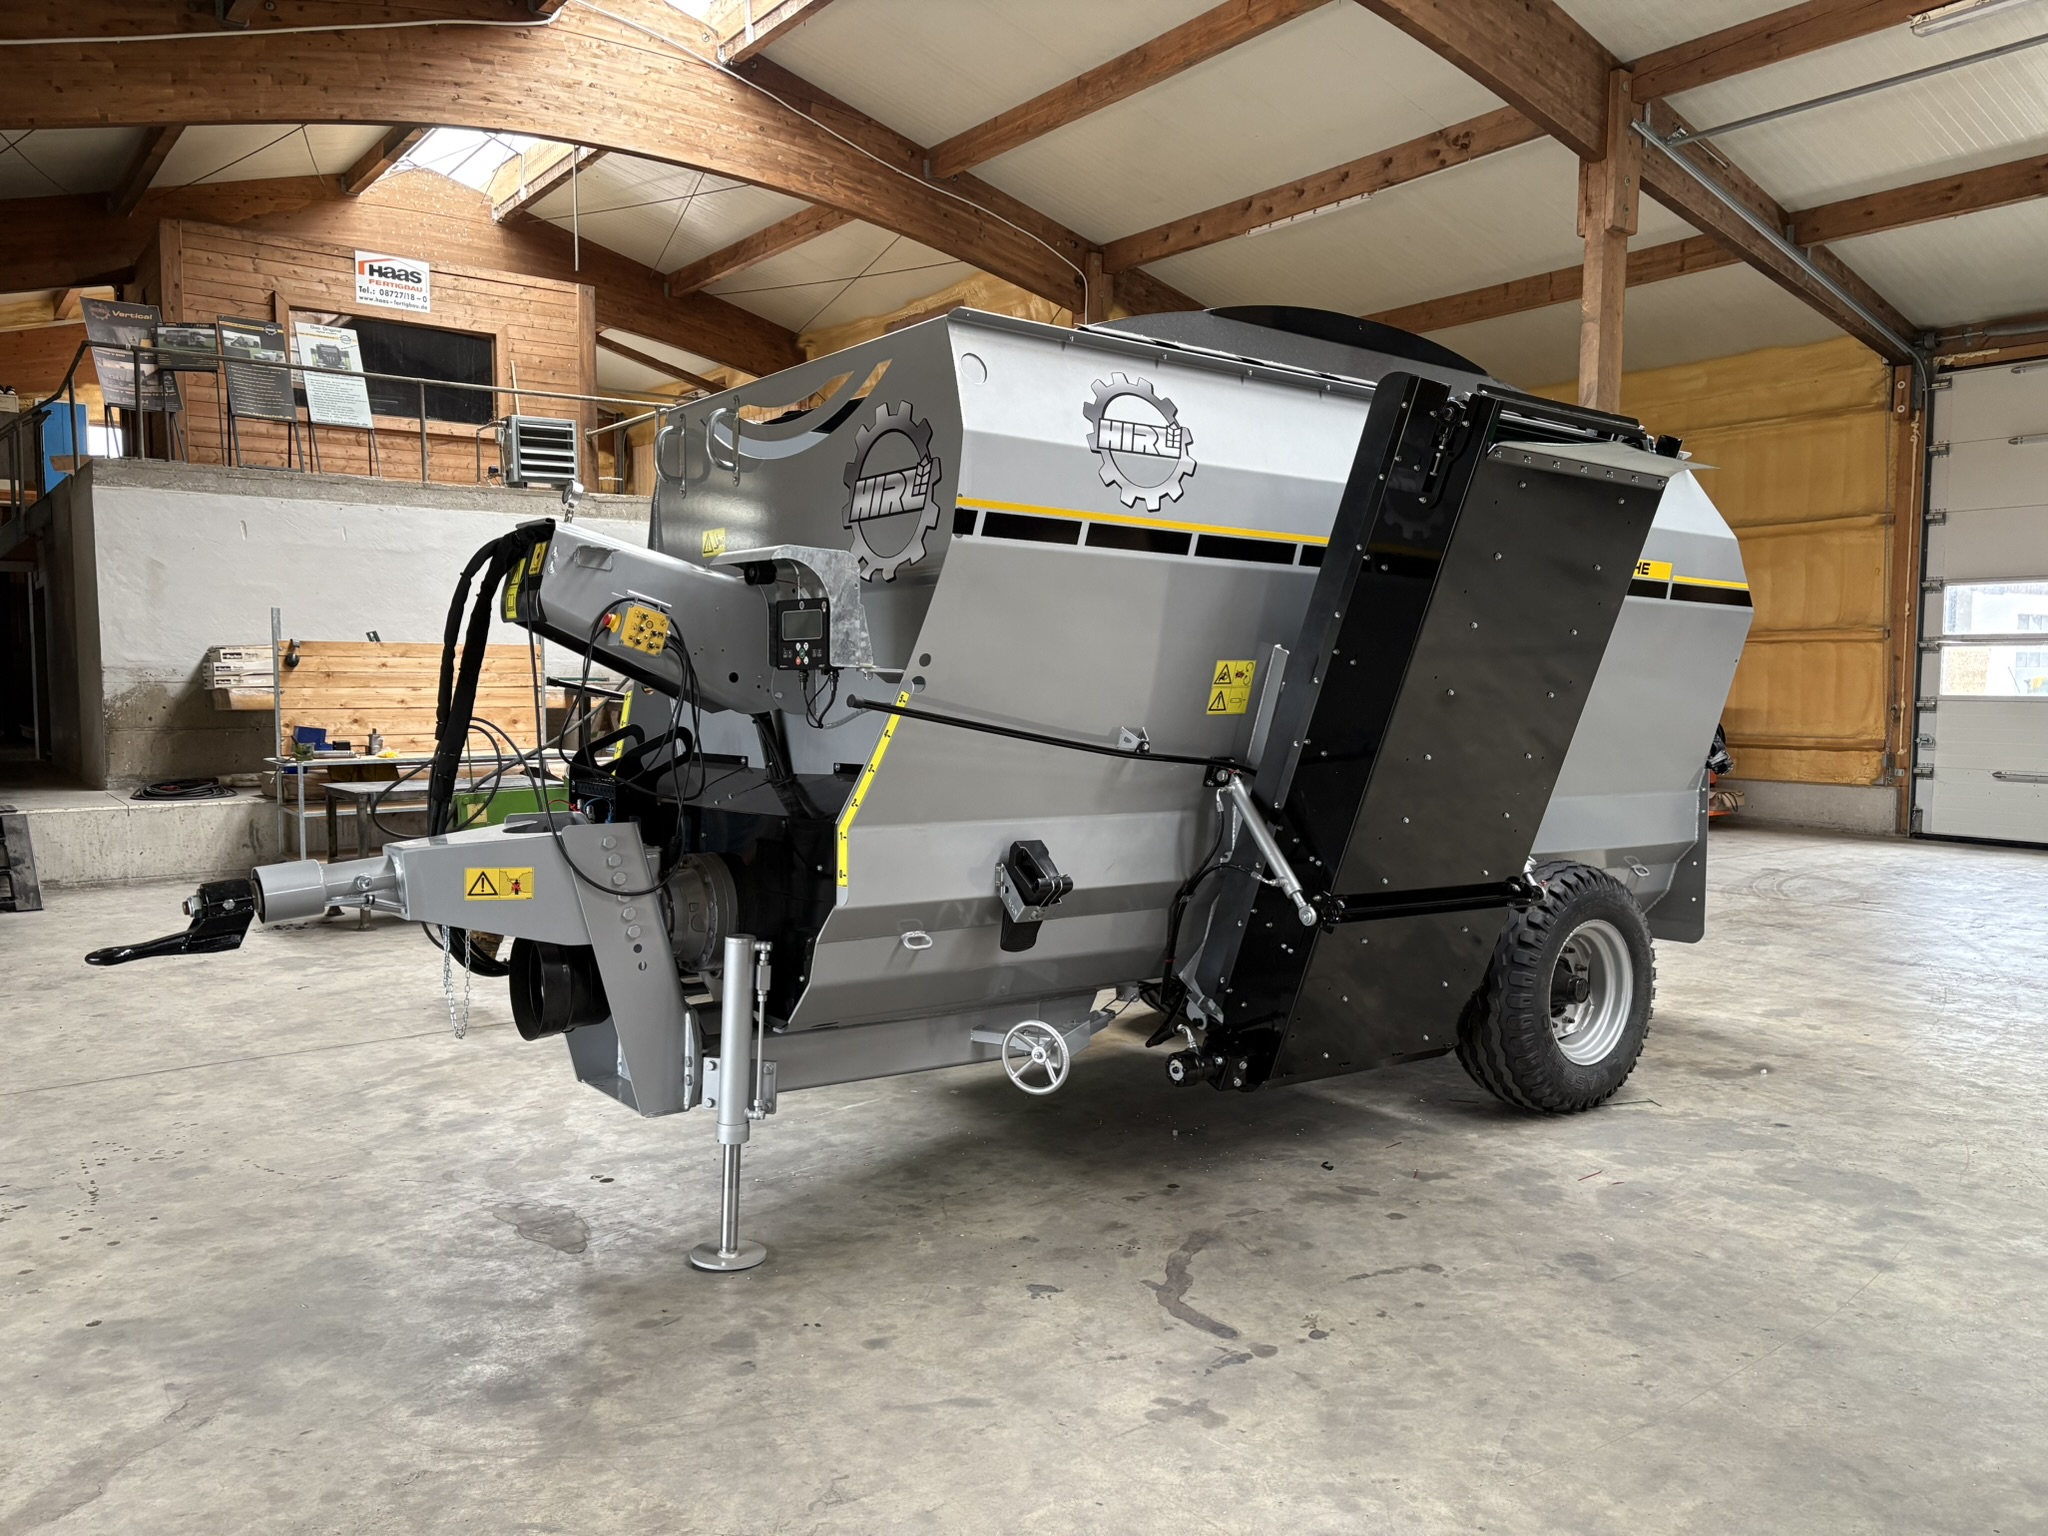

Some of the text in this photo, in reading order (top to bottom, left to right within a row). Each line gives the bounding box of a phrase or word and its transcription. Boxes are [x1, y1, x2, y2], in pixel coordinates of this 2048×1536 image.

[369, 264, 422, 284] Haas
[358, 285, 376, 295] Tel.:
[369, 279, 423, 292] FERTIGBAU
[111, 309, 153, 320] Vertical
[1097, 418, 1182, 459] HIRL
[849, 461, 931, 523] HIRL
